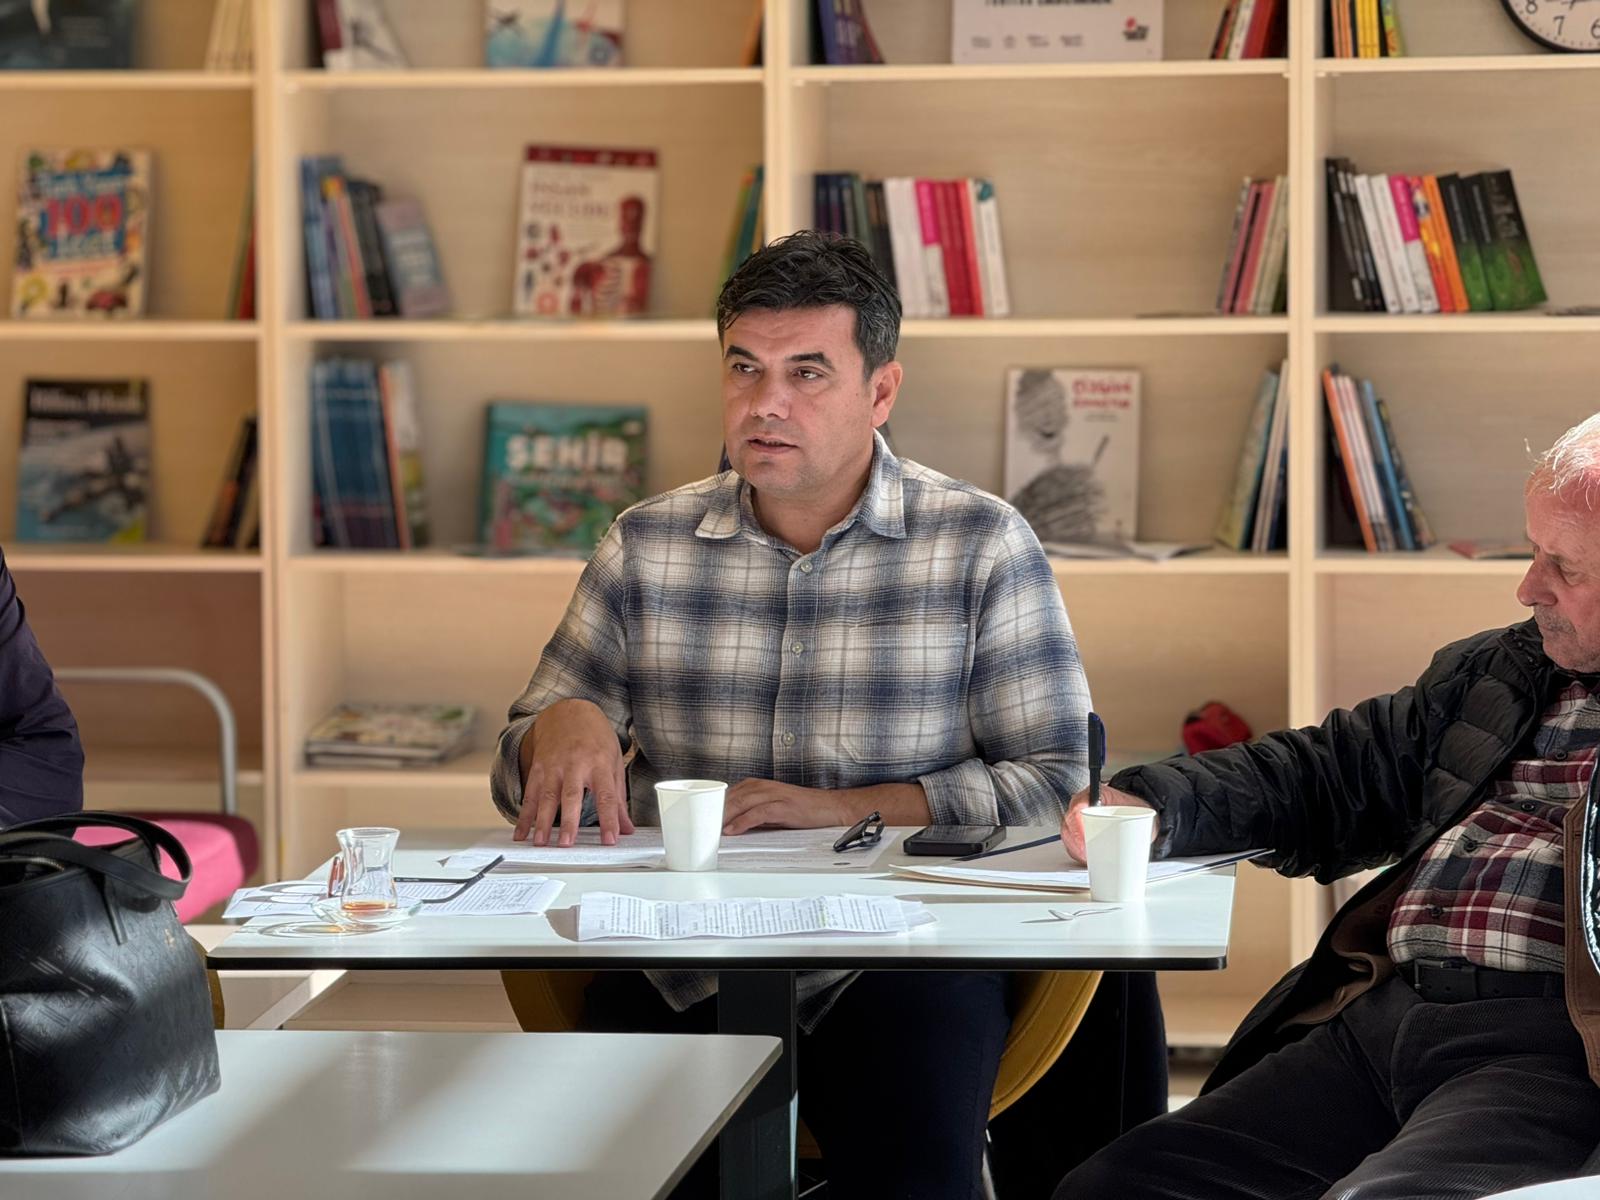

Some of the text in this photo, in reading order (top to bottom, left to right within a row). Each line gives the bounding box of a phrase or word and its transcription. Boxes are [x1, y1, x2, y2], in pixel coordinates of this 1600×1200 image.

[1526, 0, 1537, 14] 8
[1553, 15, 1565, 36] 7
[1590, 18, 1600, 39] 6
[46, 193, 123, 238] 100
